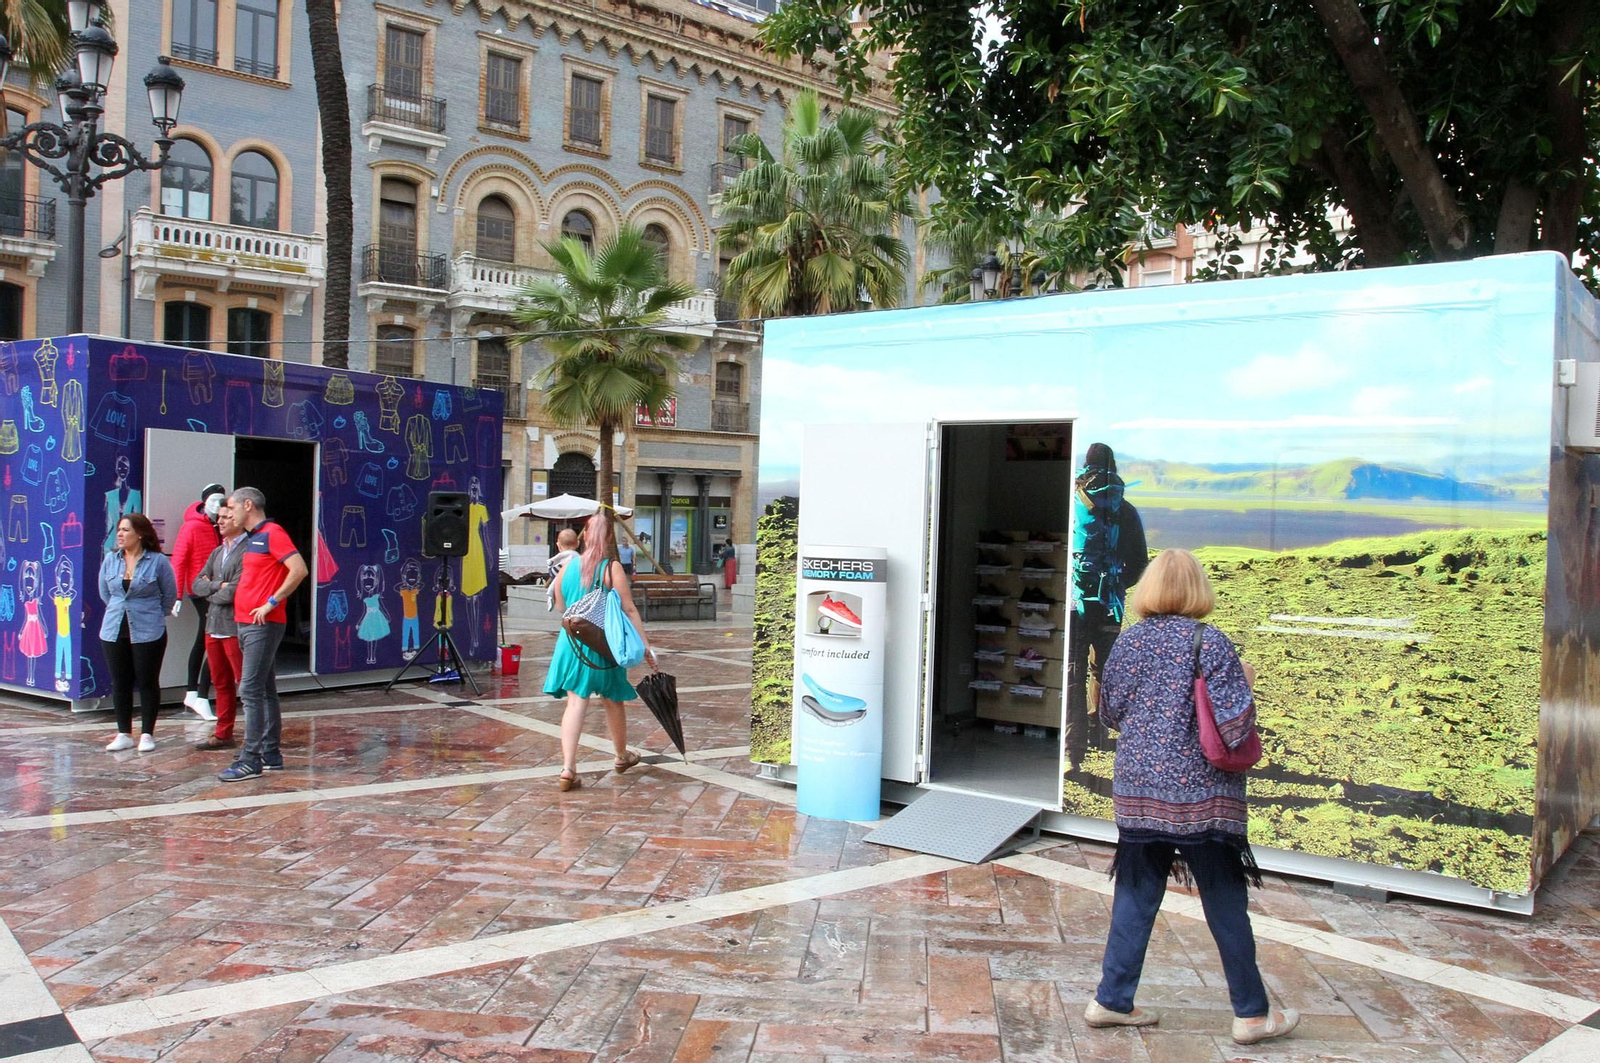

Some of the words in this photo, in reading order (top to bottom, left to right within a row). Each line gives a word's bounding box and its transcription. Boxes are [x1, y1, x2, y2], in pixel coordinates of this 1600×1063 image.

[105, 408, 127, 428] LOVE
[802, 558, 874, 571] SKECHERS
[802, 569, 838, 579] MEMORY
[839, 571, 874, 580] FOAM
[827, 649, 871, 660] included
